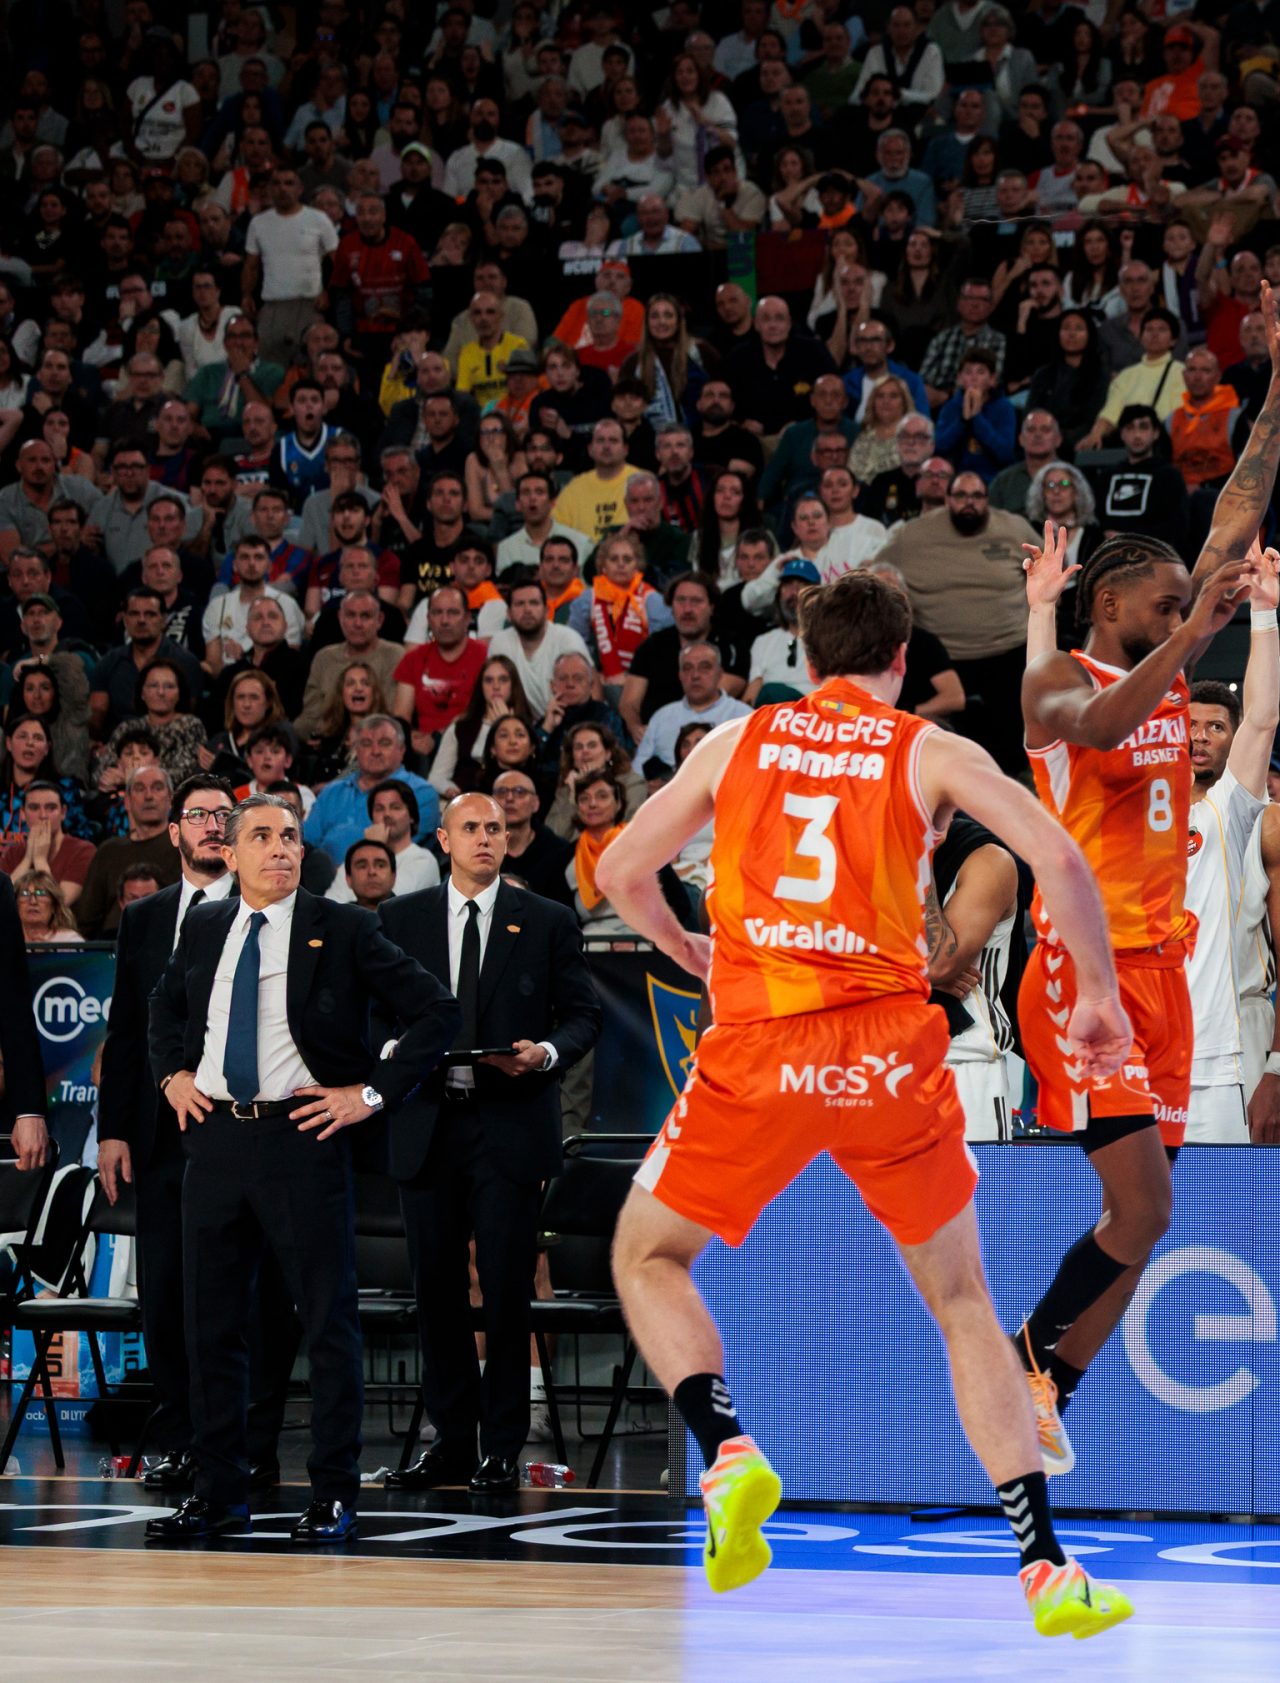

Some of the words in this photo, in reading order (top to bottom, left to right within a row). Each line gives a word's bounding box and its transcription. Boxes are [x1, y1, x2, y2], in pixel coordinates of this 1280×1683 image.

[758, 743, 885, 780] PAMESA
[1132, 747, 1181, 767] BASKET
[1148, 778, 1173, 832] 8
[773, 792, 841, 904] 3
[779, 1063, 869, 1096] MGS
[26, 1411, 46, 1421] acb
